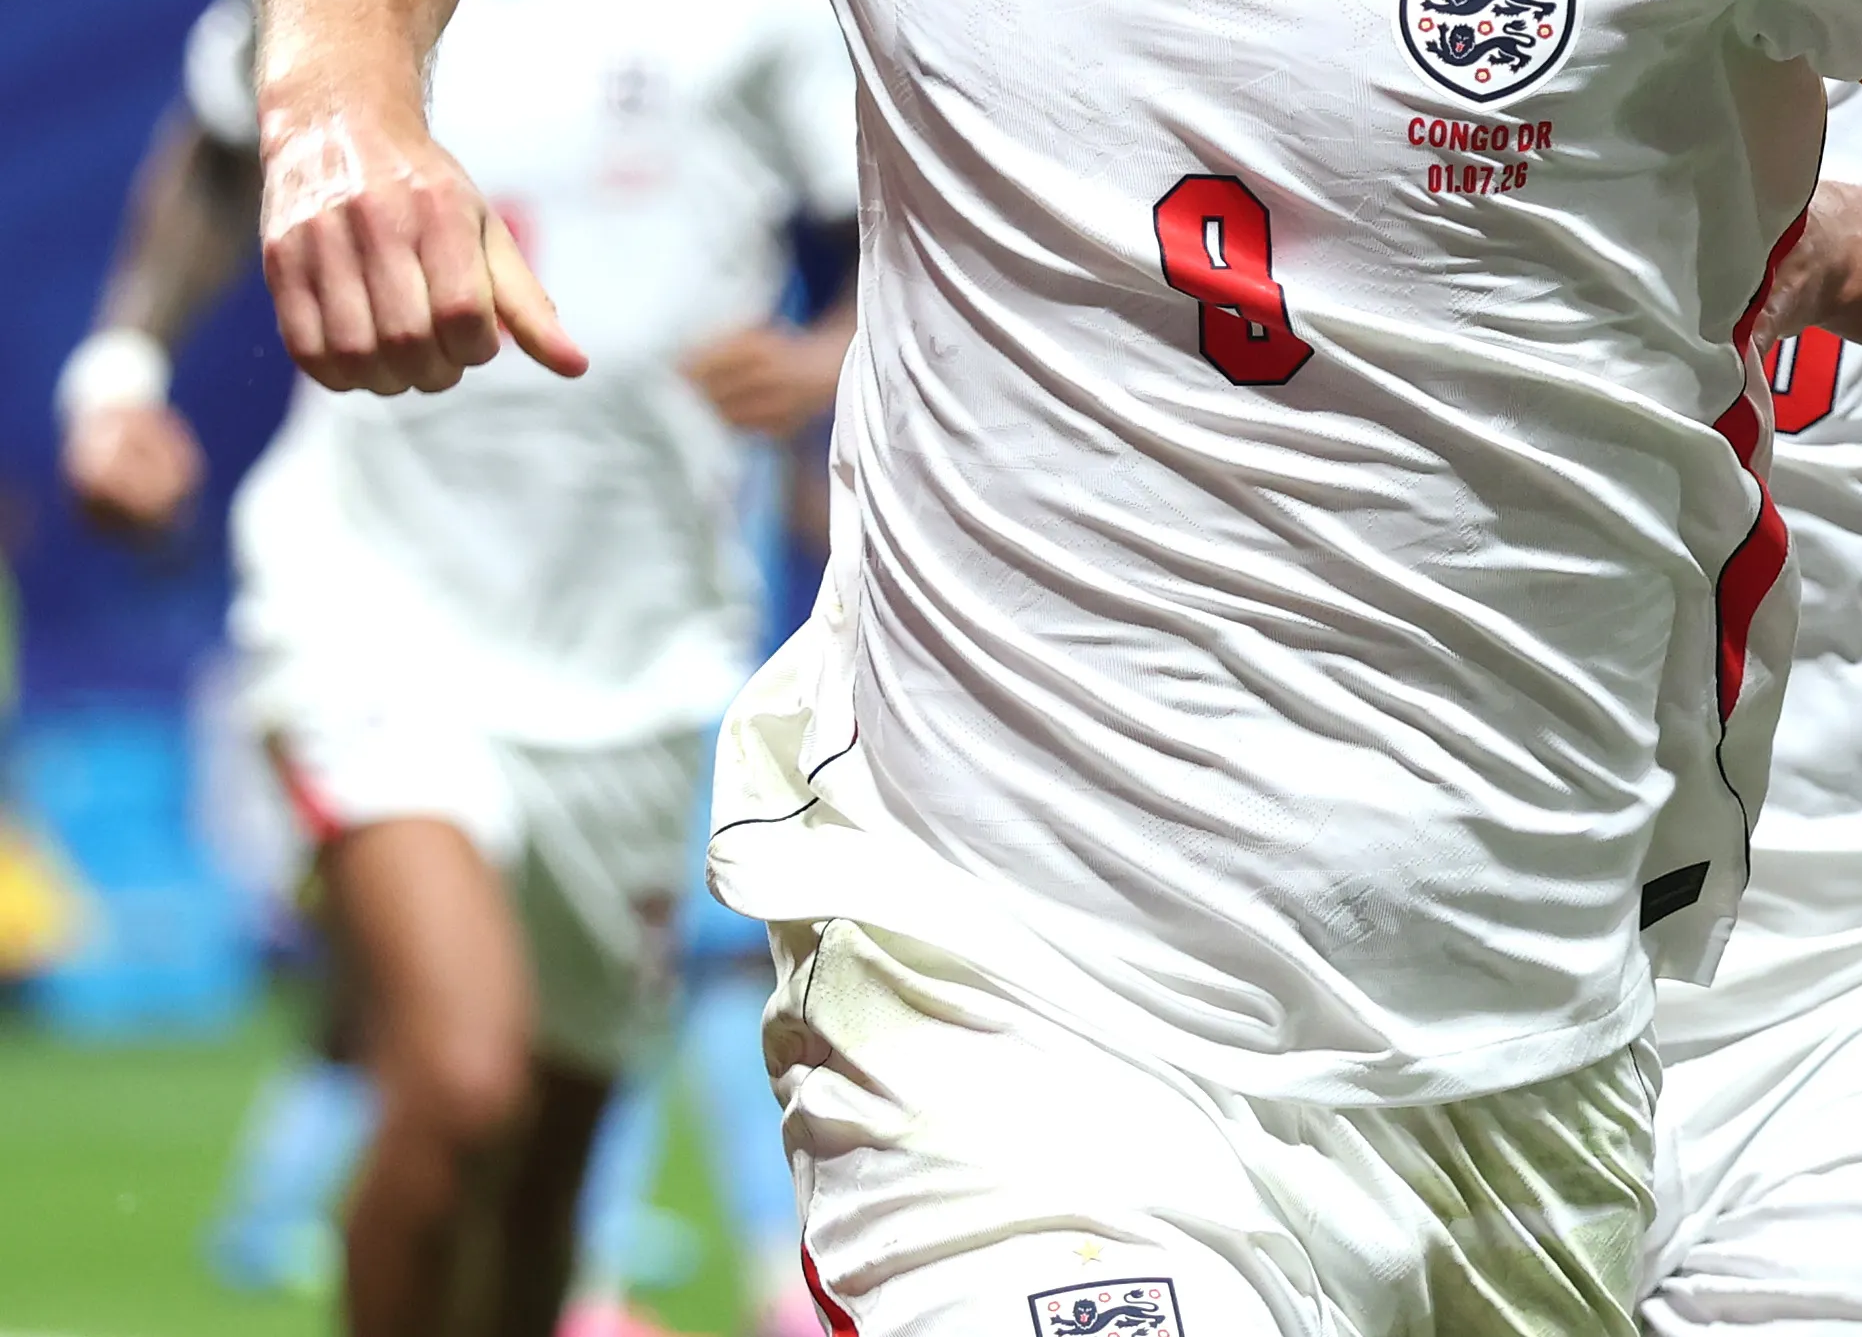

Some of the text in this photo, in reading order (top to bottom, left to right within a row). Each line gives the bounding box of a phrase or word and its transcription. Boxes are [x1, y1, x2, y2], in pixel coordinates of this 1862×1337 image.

[1408, 117, 1553, 153] CONGO DR
[1428, 162, 1528, 195] 01.07.26
